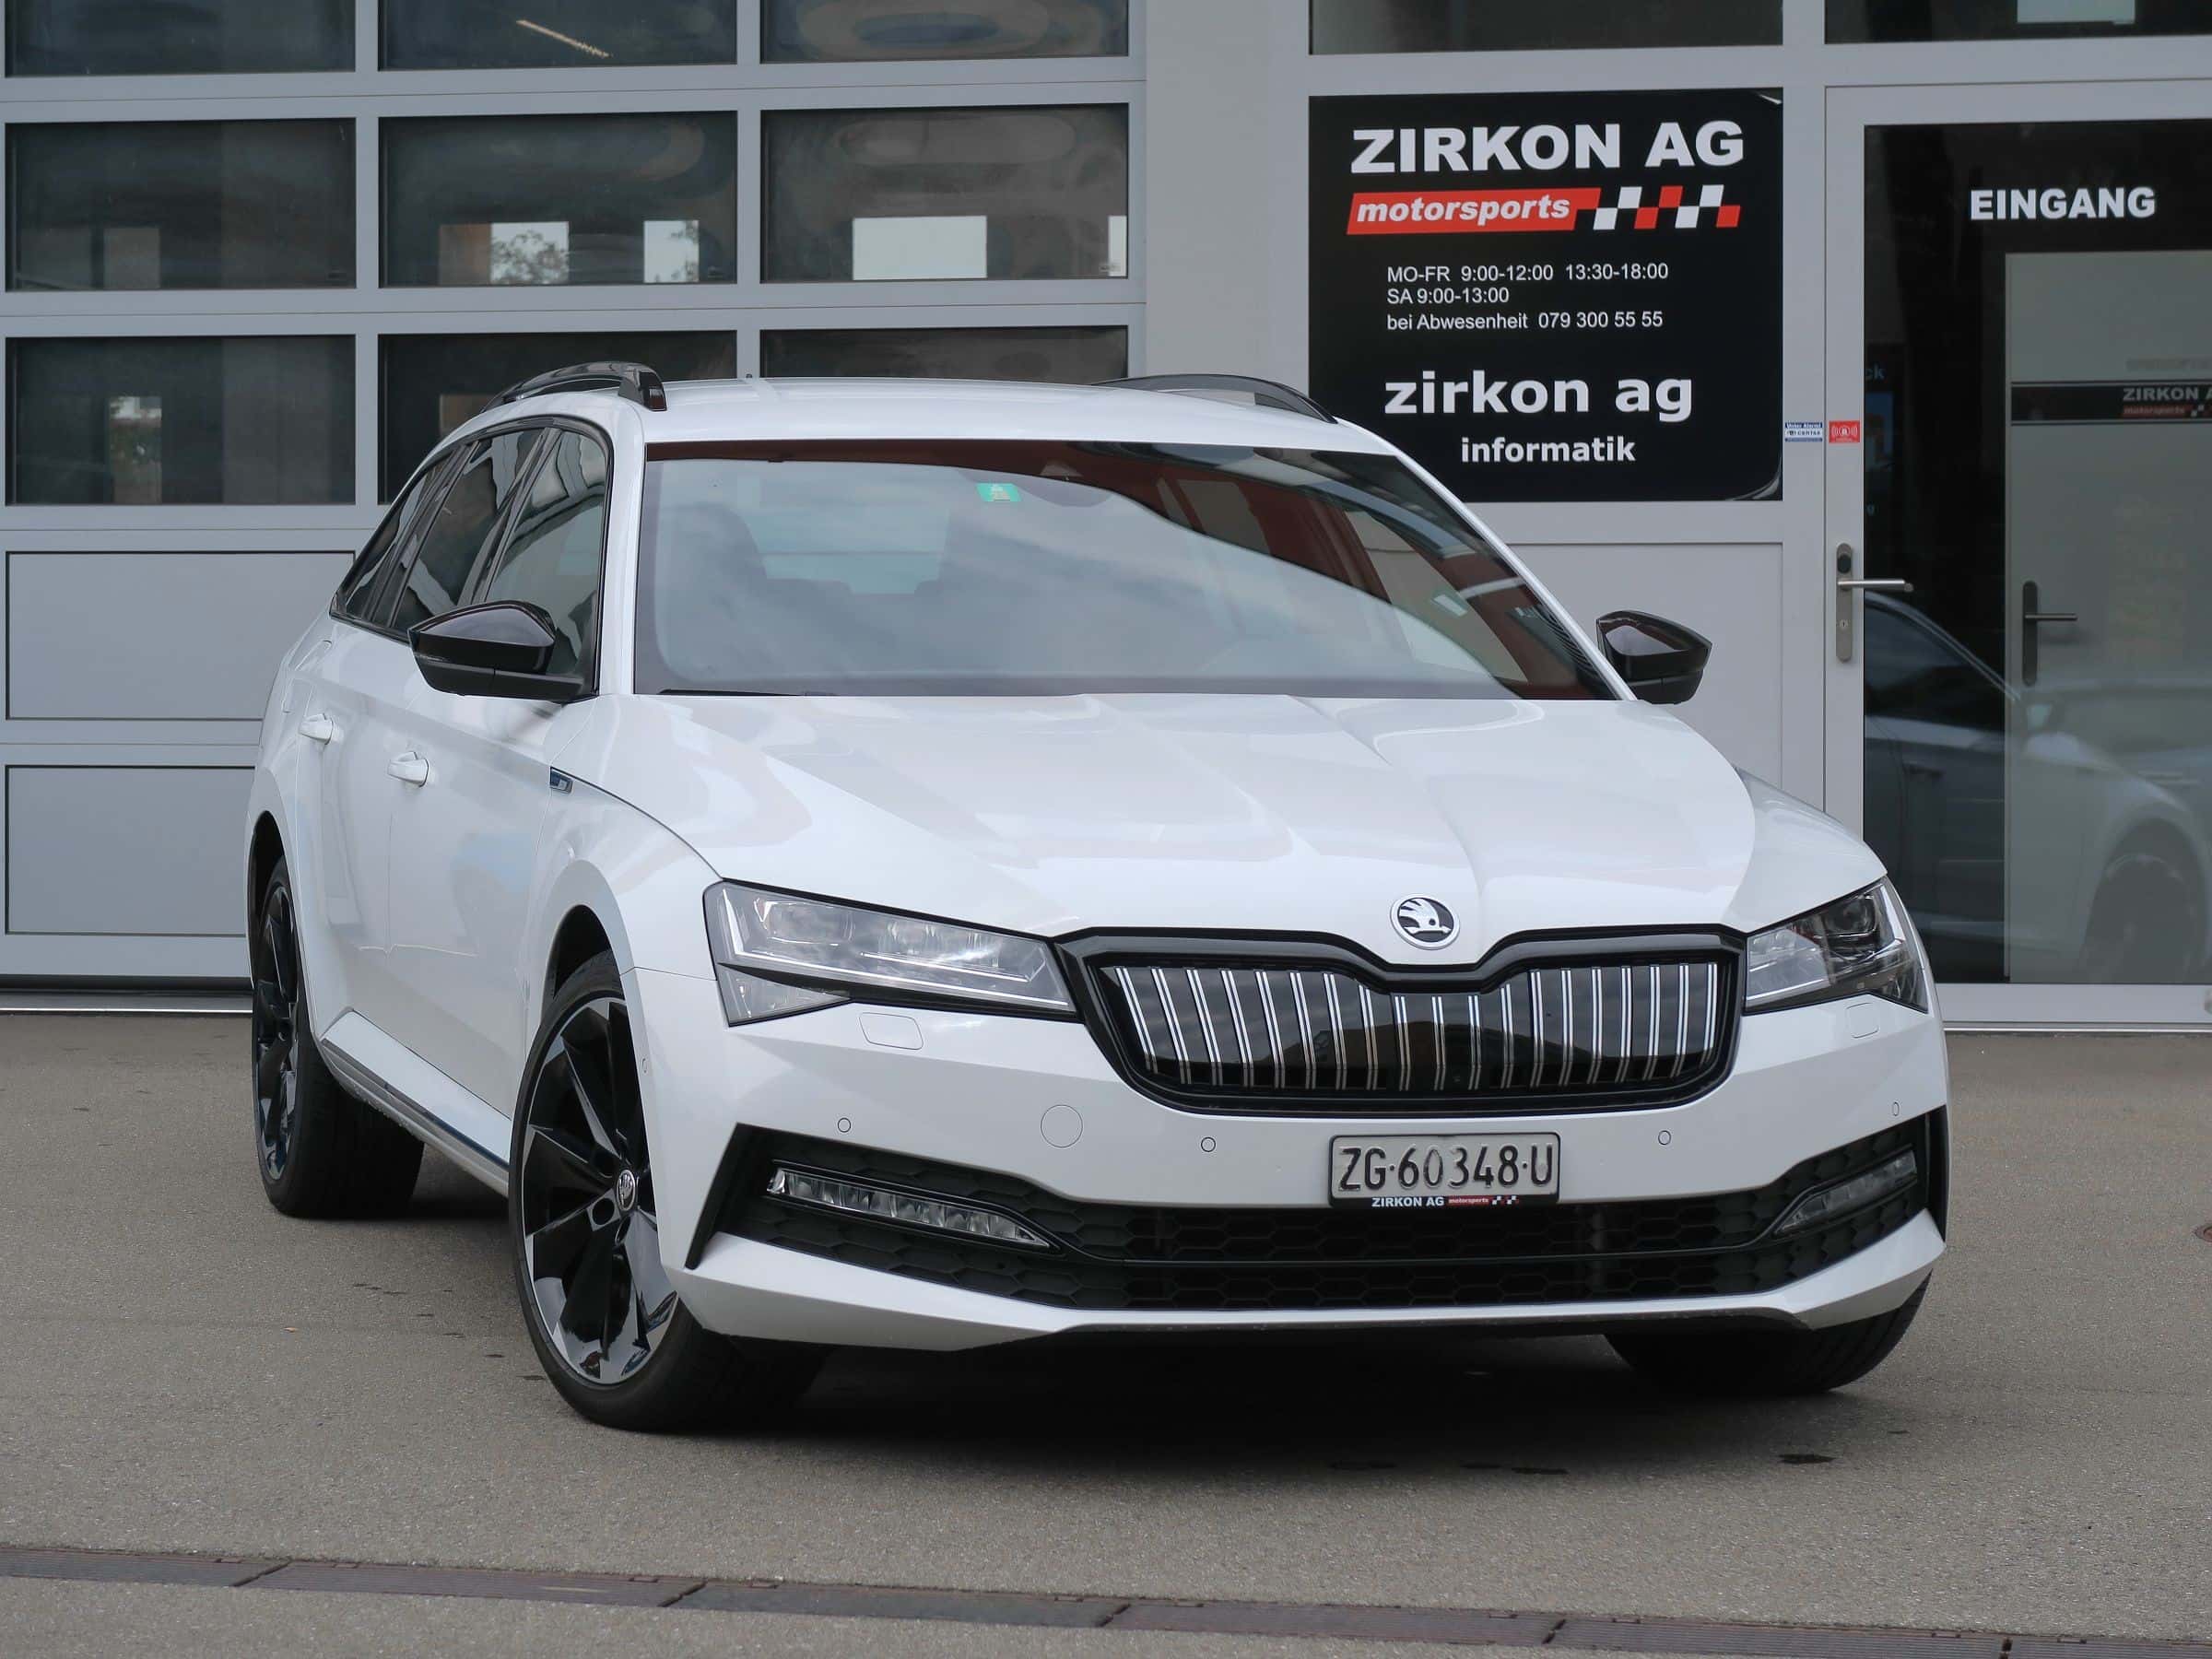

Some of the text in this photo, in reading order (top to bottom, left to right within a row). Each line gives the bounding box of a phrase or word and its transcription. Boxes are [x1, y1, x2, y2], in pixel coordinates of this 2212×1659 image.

[1350, 120, 1744, 173] ZIRKON AG
[1357, 194, 1571, 226] motorsports
[1971, 186, 2156, 220] EINGANG
[1387, 262, 1669, 283] MO-FR 9:00-12:00 13:30-18:00
[1386, 287, 1510, 305] SA 9:00-13:00
[1386, 311, 1664, 331] bei Abwesenheit 079 300 55 55
[1384, 370, 1692, 422] zirkon ag
[2123, 387, 2199, 401] ZIRKON
[1462, 435, 1636, 463] informatik
[1371, 1196, 1489, 1207] ZIRKON AG motorsports
